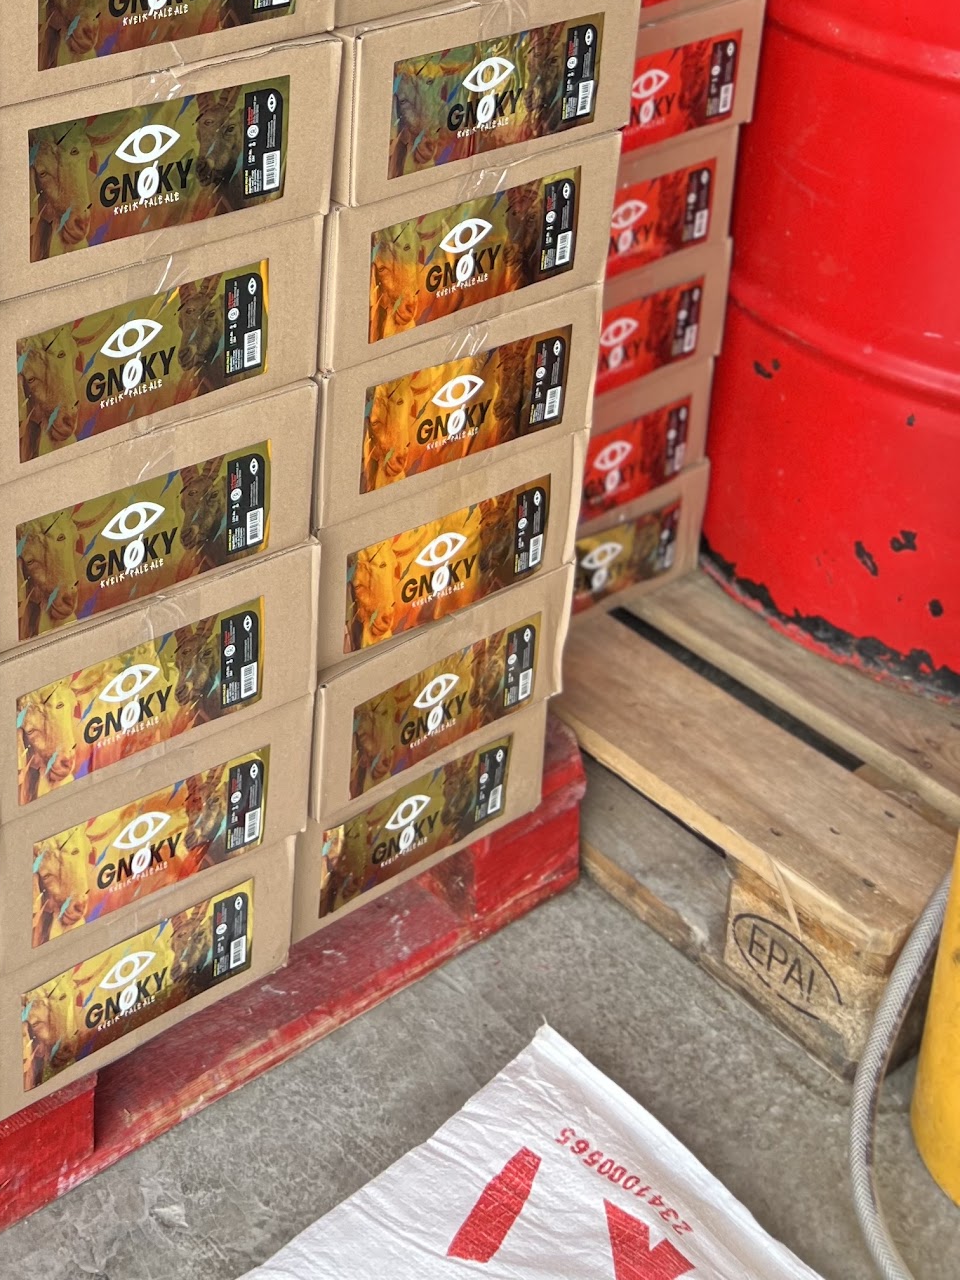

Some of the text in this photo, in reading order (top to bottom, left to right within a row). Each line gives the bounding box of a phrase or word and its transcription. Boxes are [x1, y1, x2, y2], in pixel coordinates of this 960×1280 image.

[153, 6, 173, 20] PALE
[174, 3, 188, 15] ALE
[144, 194, 163, 208] PALE
[165, 191, 178, 203] ALE
[460, 277, 476, 290] PALE
[477, 272, 488, 284] ALE
[129, 383, 147, 398] PALE
[149, 378, 162, 391] ALE
[130, 563, 148, 577] PALE
[150, 557, 164, 570] ALE
